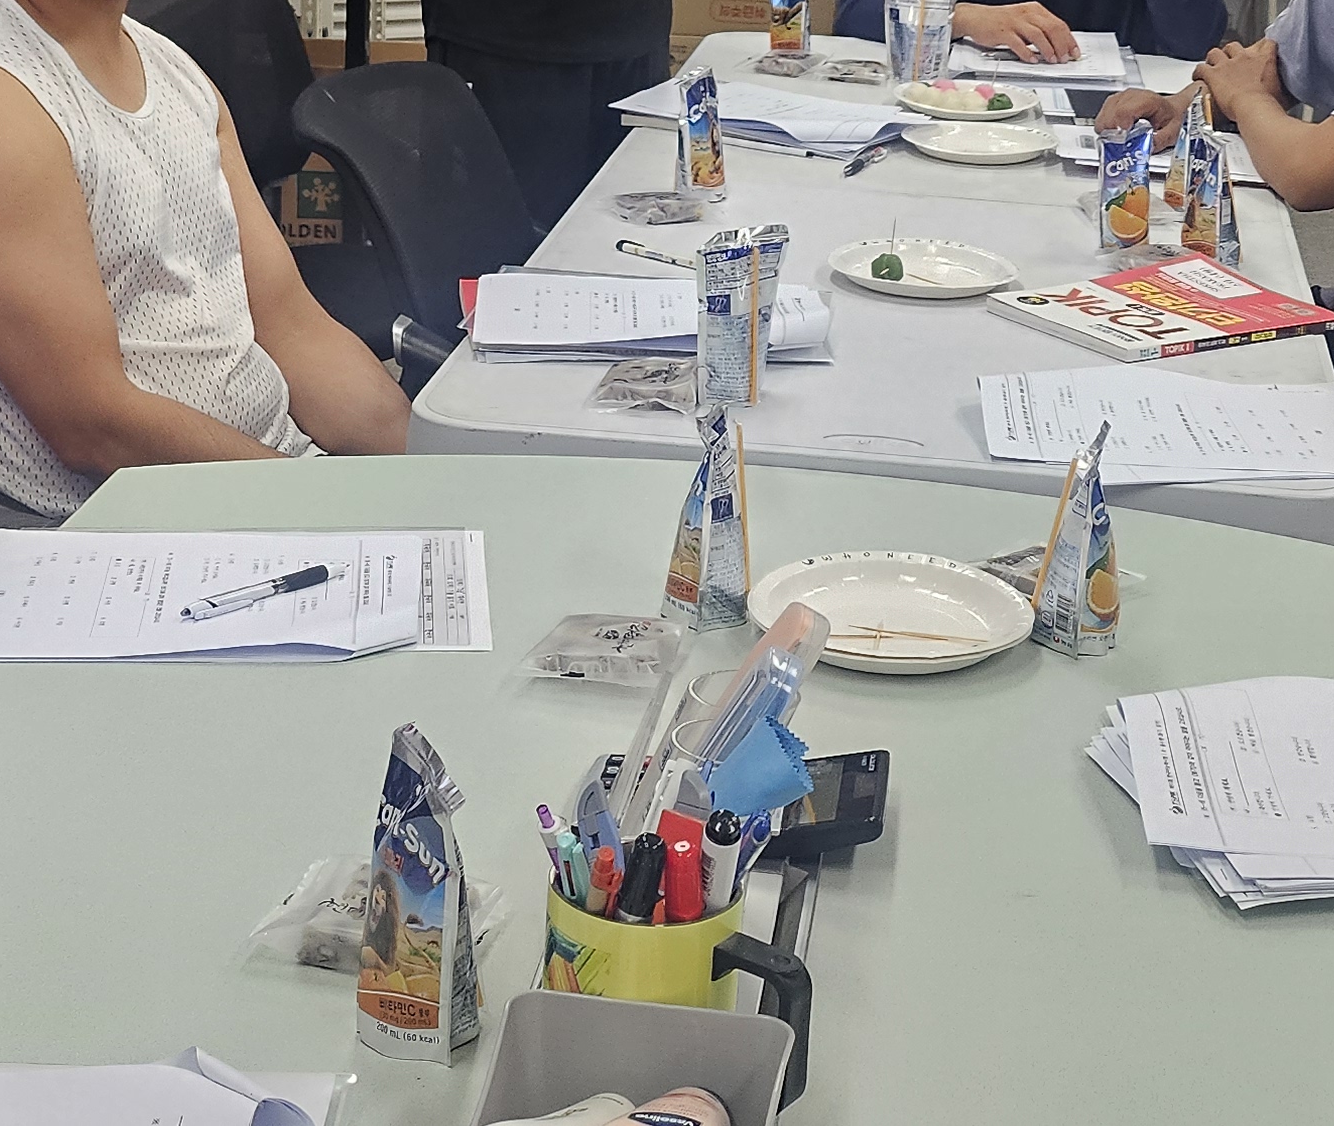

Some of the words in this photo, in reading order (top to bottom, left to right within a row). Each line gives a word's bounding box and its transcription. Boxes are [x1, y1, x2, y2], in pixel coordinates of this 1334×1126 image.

[1037, 287, 1191, 339] TOPIK
[1164, 345, 1186, 355] TOPIK
[378, 995, 416, 1017] 비타민C
[376, 1021, 389, 1035] 200
[389, 1029, 401, 1040] mL
[402, 1031, 417, 1042] (60
[419, 1034, 440, 1045] kcal)
